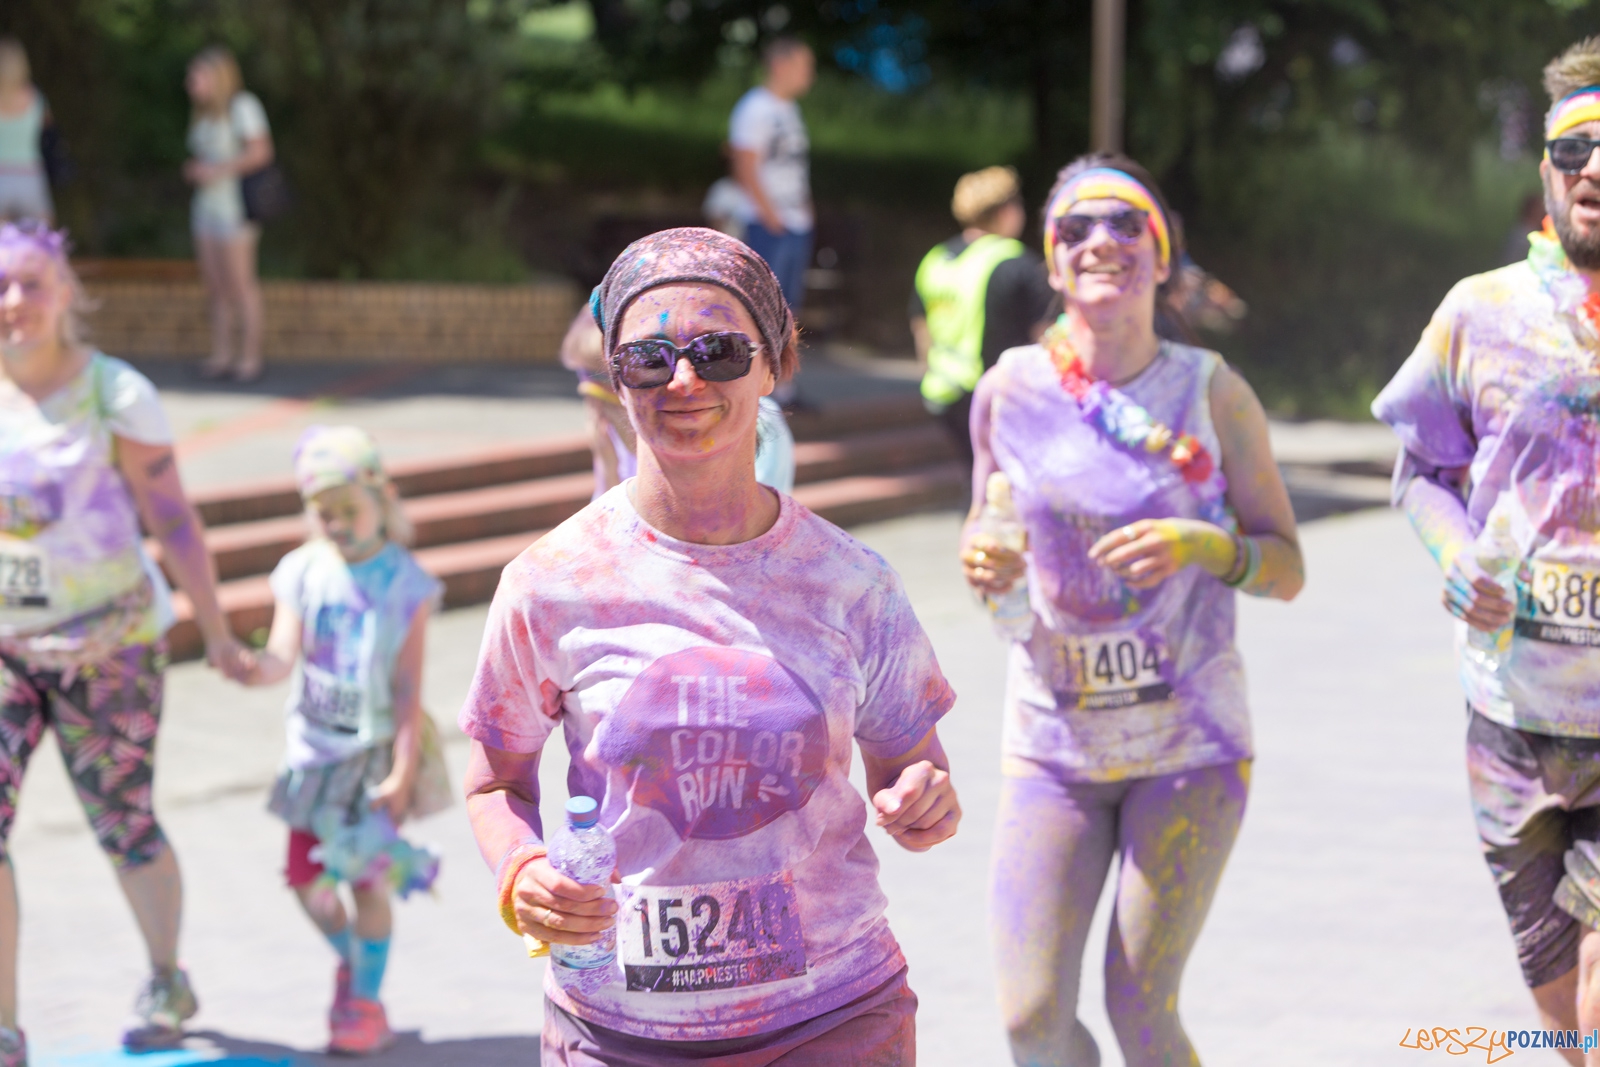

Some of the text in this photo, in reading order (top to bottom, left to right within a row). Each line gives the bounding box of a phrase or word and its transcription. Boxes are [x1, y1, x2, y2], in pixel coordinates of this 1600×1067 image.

[671, 674, 750, 727] THE
[670, 728, 805, 778] COLOR
[676, 765, 748, 823] RUN
